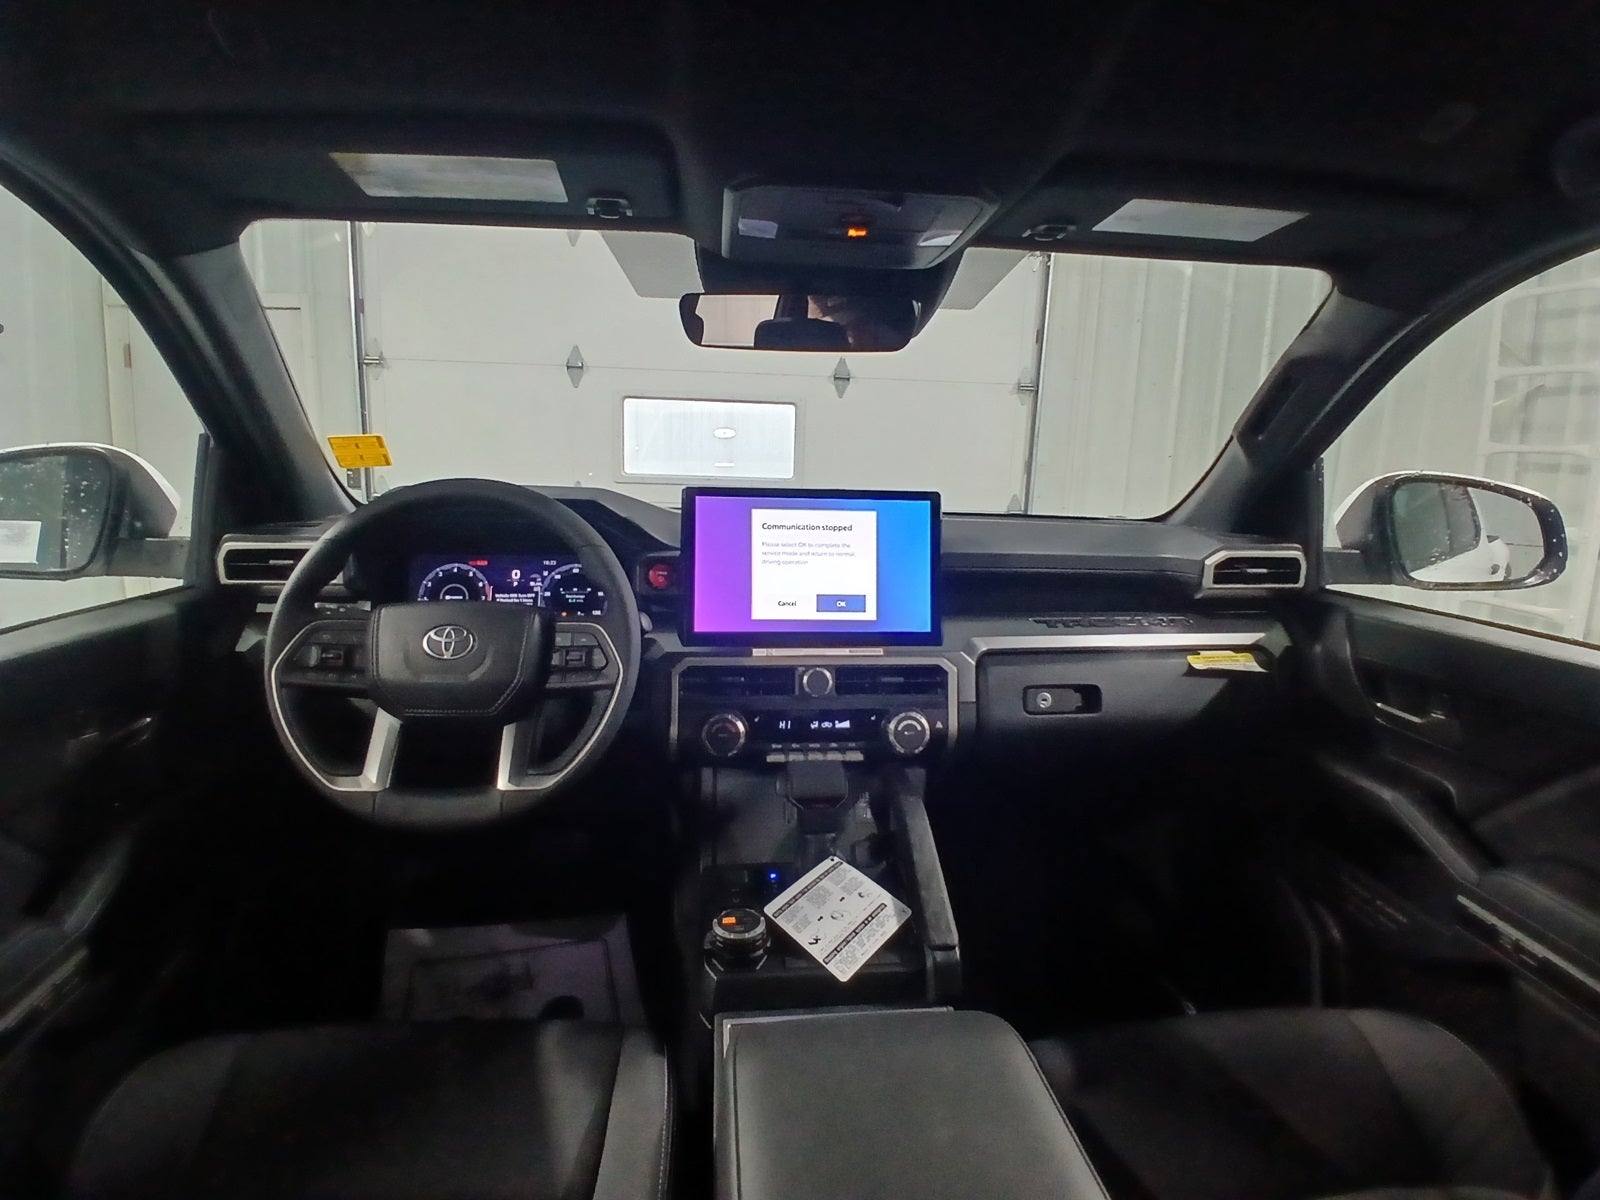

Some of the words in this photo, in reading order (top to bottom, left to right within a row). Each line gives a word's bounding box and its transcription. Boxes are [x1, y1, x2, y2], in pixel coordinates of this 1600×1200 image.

[761, 522, 820, 531] Communication
[821, 523, 853, 532] stopped
[512, 569, 521, 580] 0
